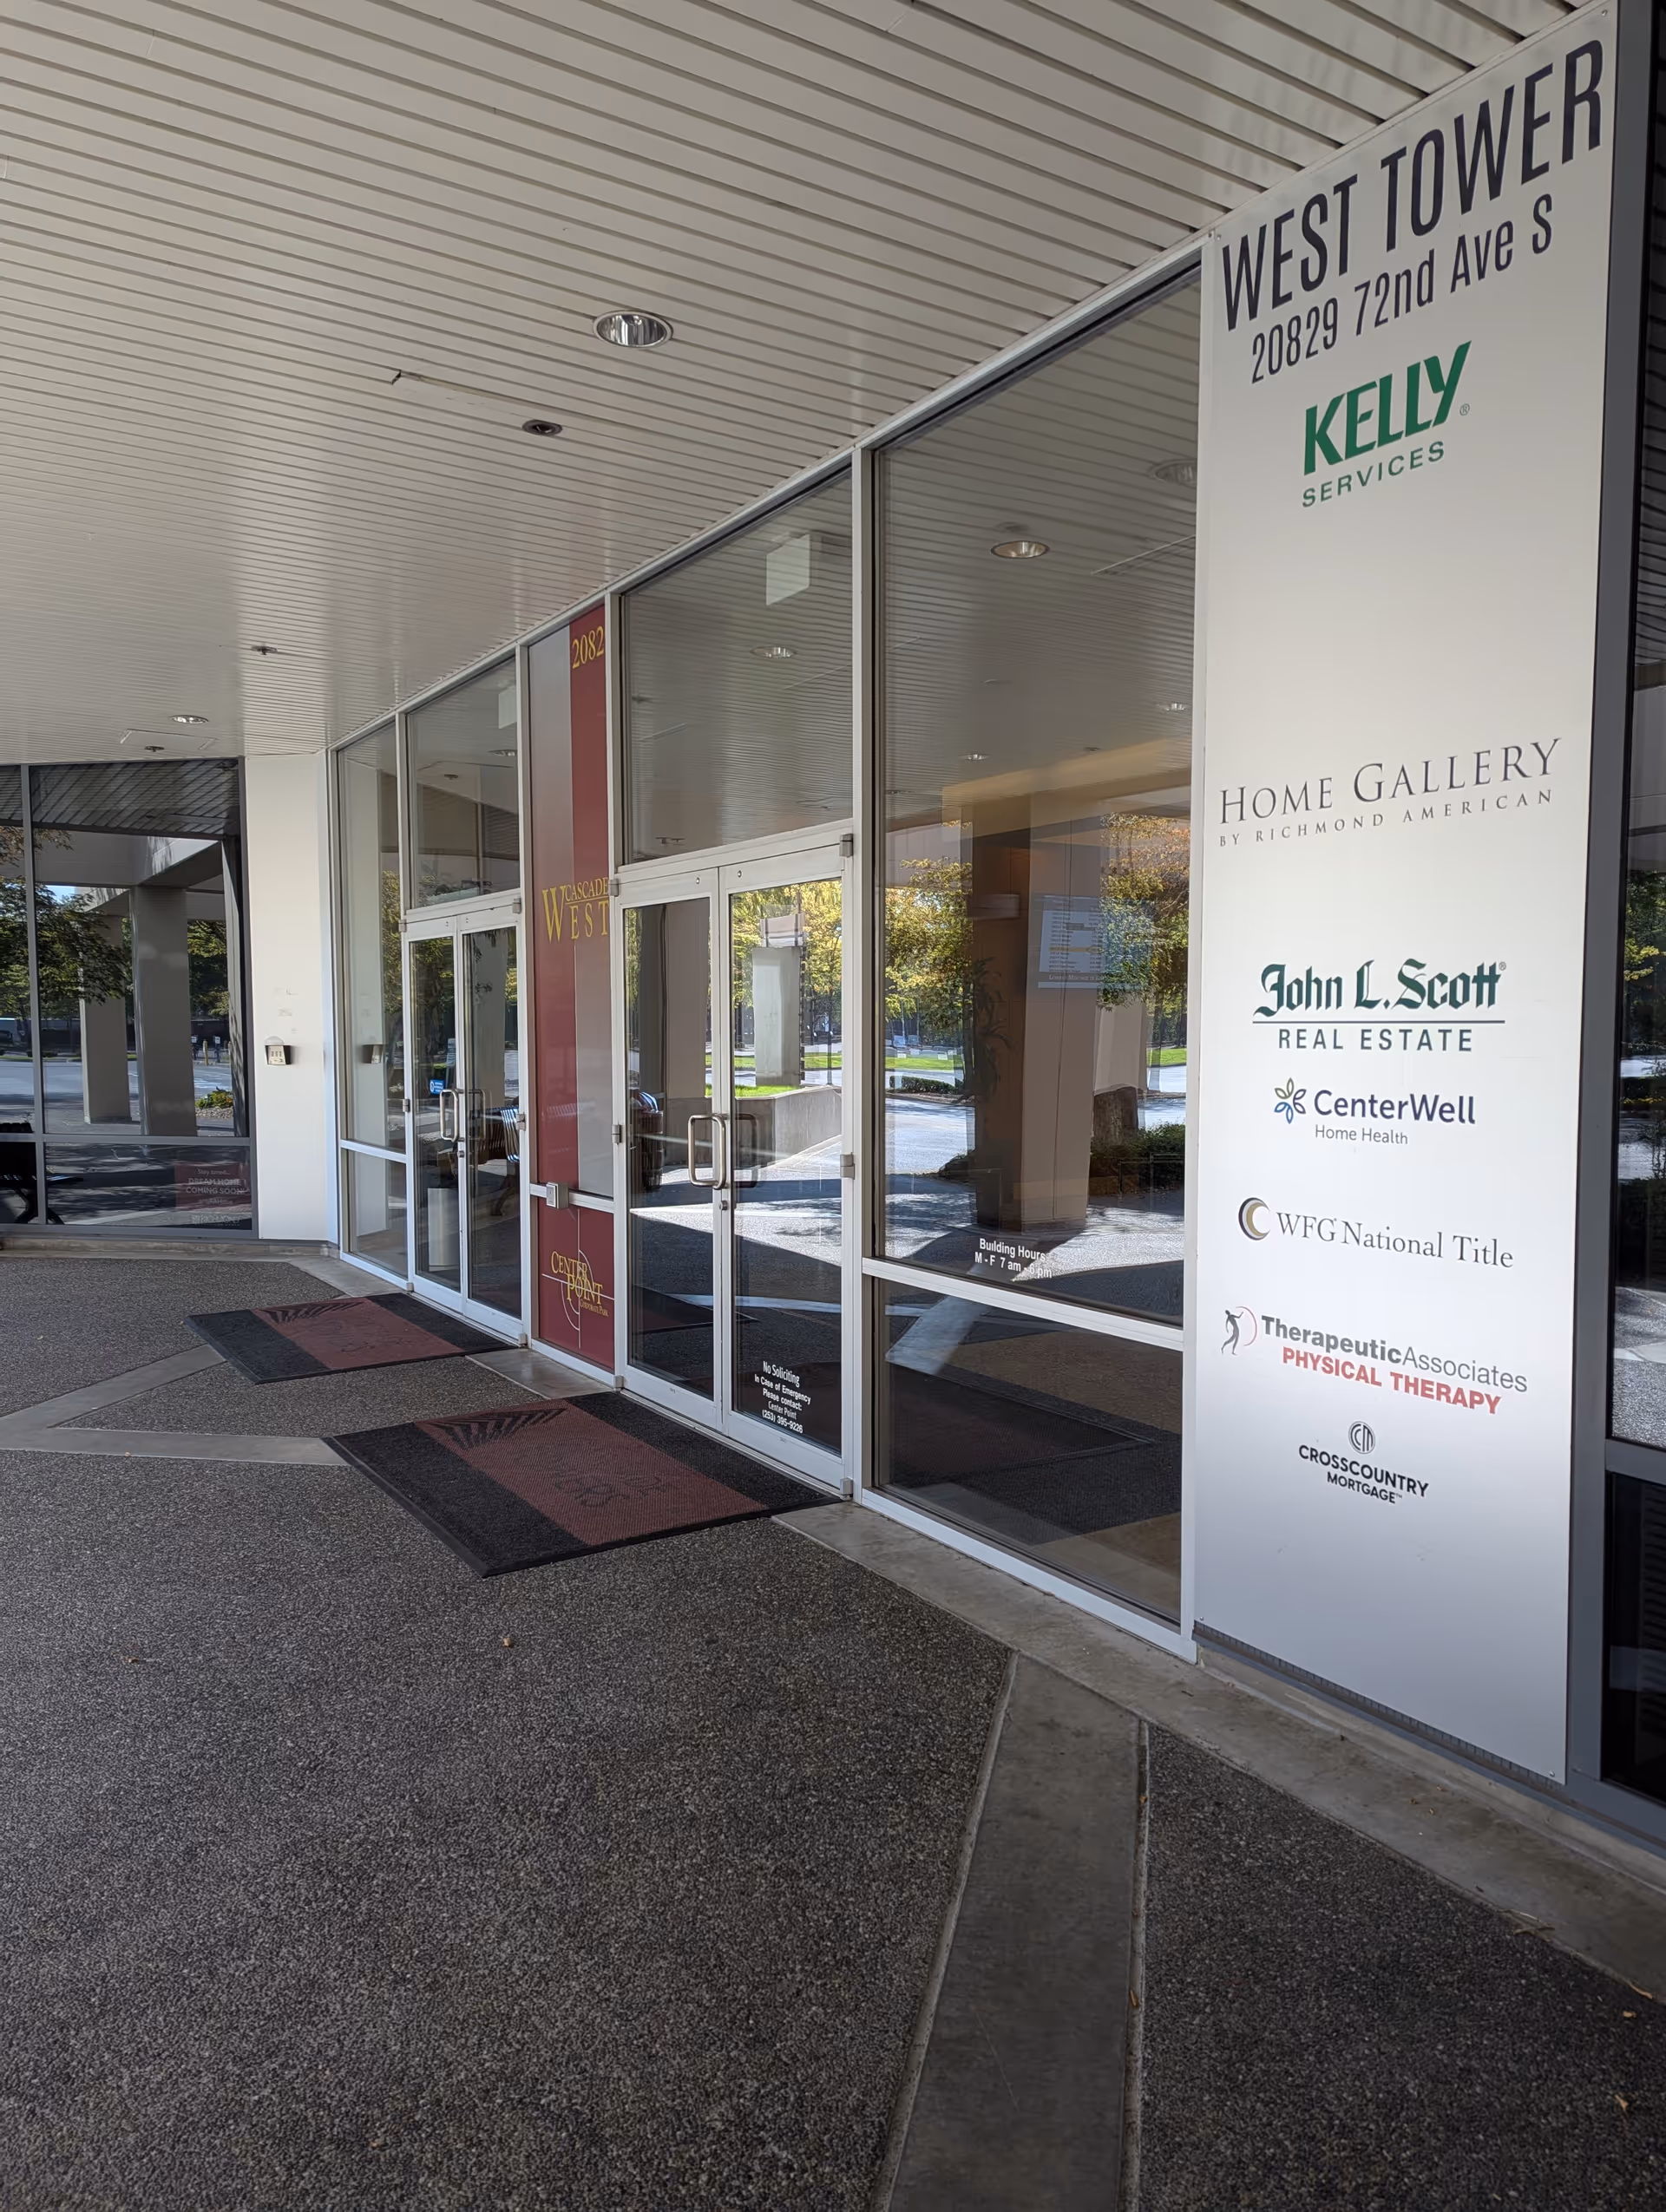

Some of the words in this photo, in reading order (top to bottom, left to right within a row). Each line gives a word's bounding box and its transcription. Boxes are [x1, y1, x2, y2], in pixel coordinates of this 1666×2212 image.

[1222, 174, 1358, 331] WEST
[1381, 40, 1604, 252] TOWER
[1251, 298, 1337, 384] 20829
[1354, 249, 1434, 337] 72nd
[1450, 220, 1513, 293] Ave
[1532, 193, 1552, 253] S
[1302, 442, 1444, 507] SERVICES
[1220, 777, 1333, 824] HOME
[1354, 737, 1562, 802] GALLERY
[1220, 834, 1240, 847] BY
[1256, 814, 1384, 842] RICHMOND
[1402, 789, 1552, 823] AMERICAN
[542, 886, 609, 944] WEST
[1253, 963, 1342, 1017] John
[1279, 1029, 1343, 1049] REAL
[1361, 1029, 1472, 1051] ESTATE
[1314, 1090, 1475, 1124] CenterWell
[1315, 1124, 1357, 1141] Home
[1362, 1128, 1408, 1144] Health
[980, 1238, 1015, 1258] Building
[1018, 1246, 1046, 1261] Hours
[1341, 1221, 1444, 1258] National
[1453, 1235, 1514, 1267] Title
[551, 1251, 587, 1279] CENTER
[975, 1252, 982, 1263] M
[990, 1254, 995, 1266] F
[1000, 1257, 1006, 1267] 7
[1007, 1261, 1020, 1272] am
[1038, 1267, 1052, 1279] pm
[567, 1273, 603, 1305] POINT
[754, 1374, 759, 1383] In
[760, 1377, 773, 1389] Case
[782, 1385, 811, 1404] Emergency
[764, 1361, 771, 1374] No
[772, 1365, 799, 1388] Soliciting
[1282, 1346, 1381, 1387] PHYSICAL
[1390, 1371, 1501, 1414] THERAPY
[763, 1388, 779, 1402] Please
[769, 1401, 783, 1414] Center
[784, 1408, 797, 1419] Point
[763, 1410, 776, 1422] (253)
[1299, 1444, 1429, 1498] CROSSCOUNTRY
